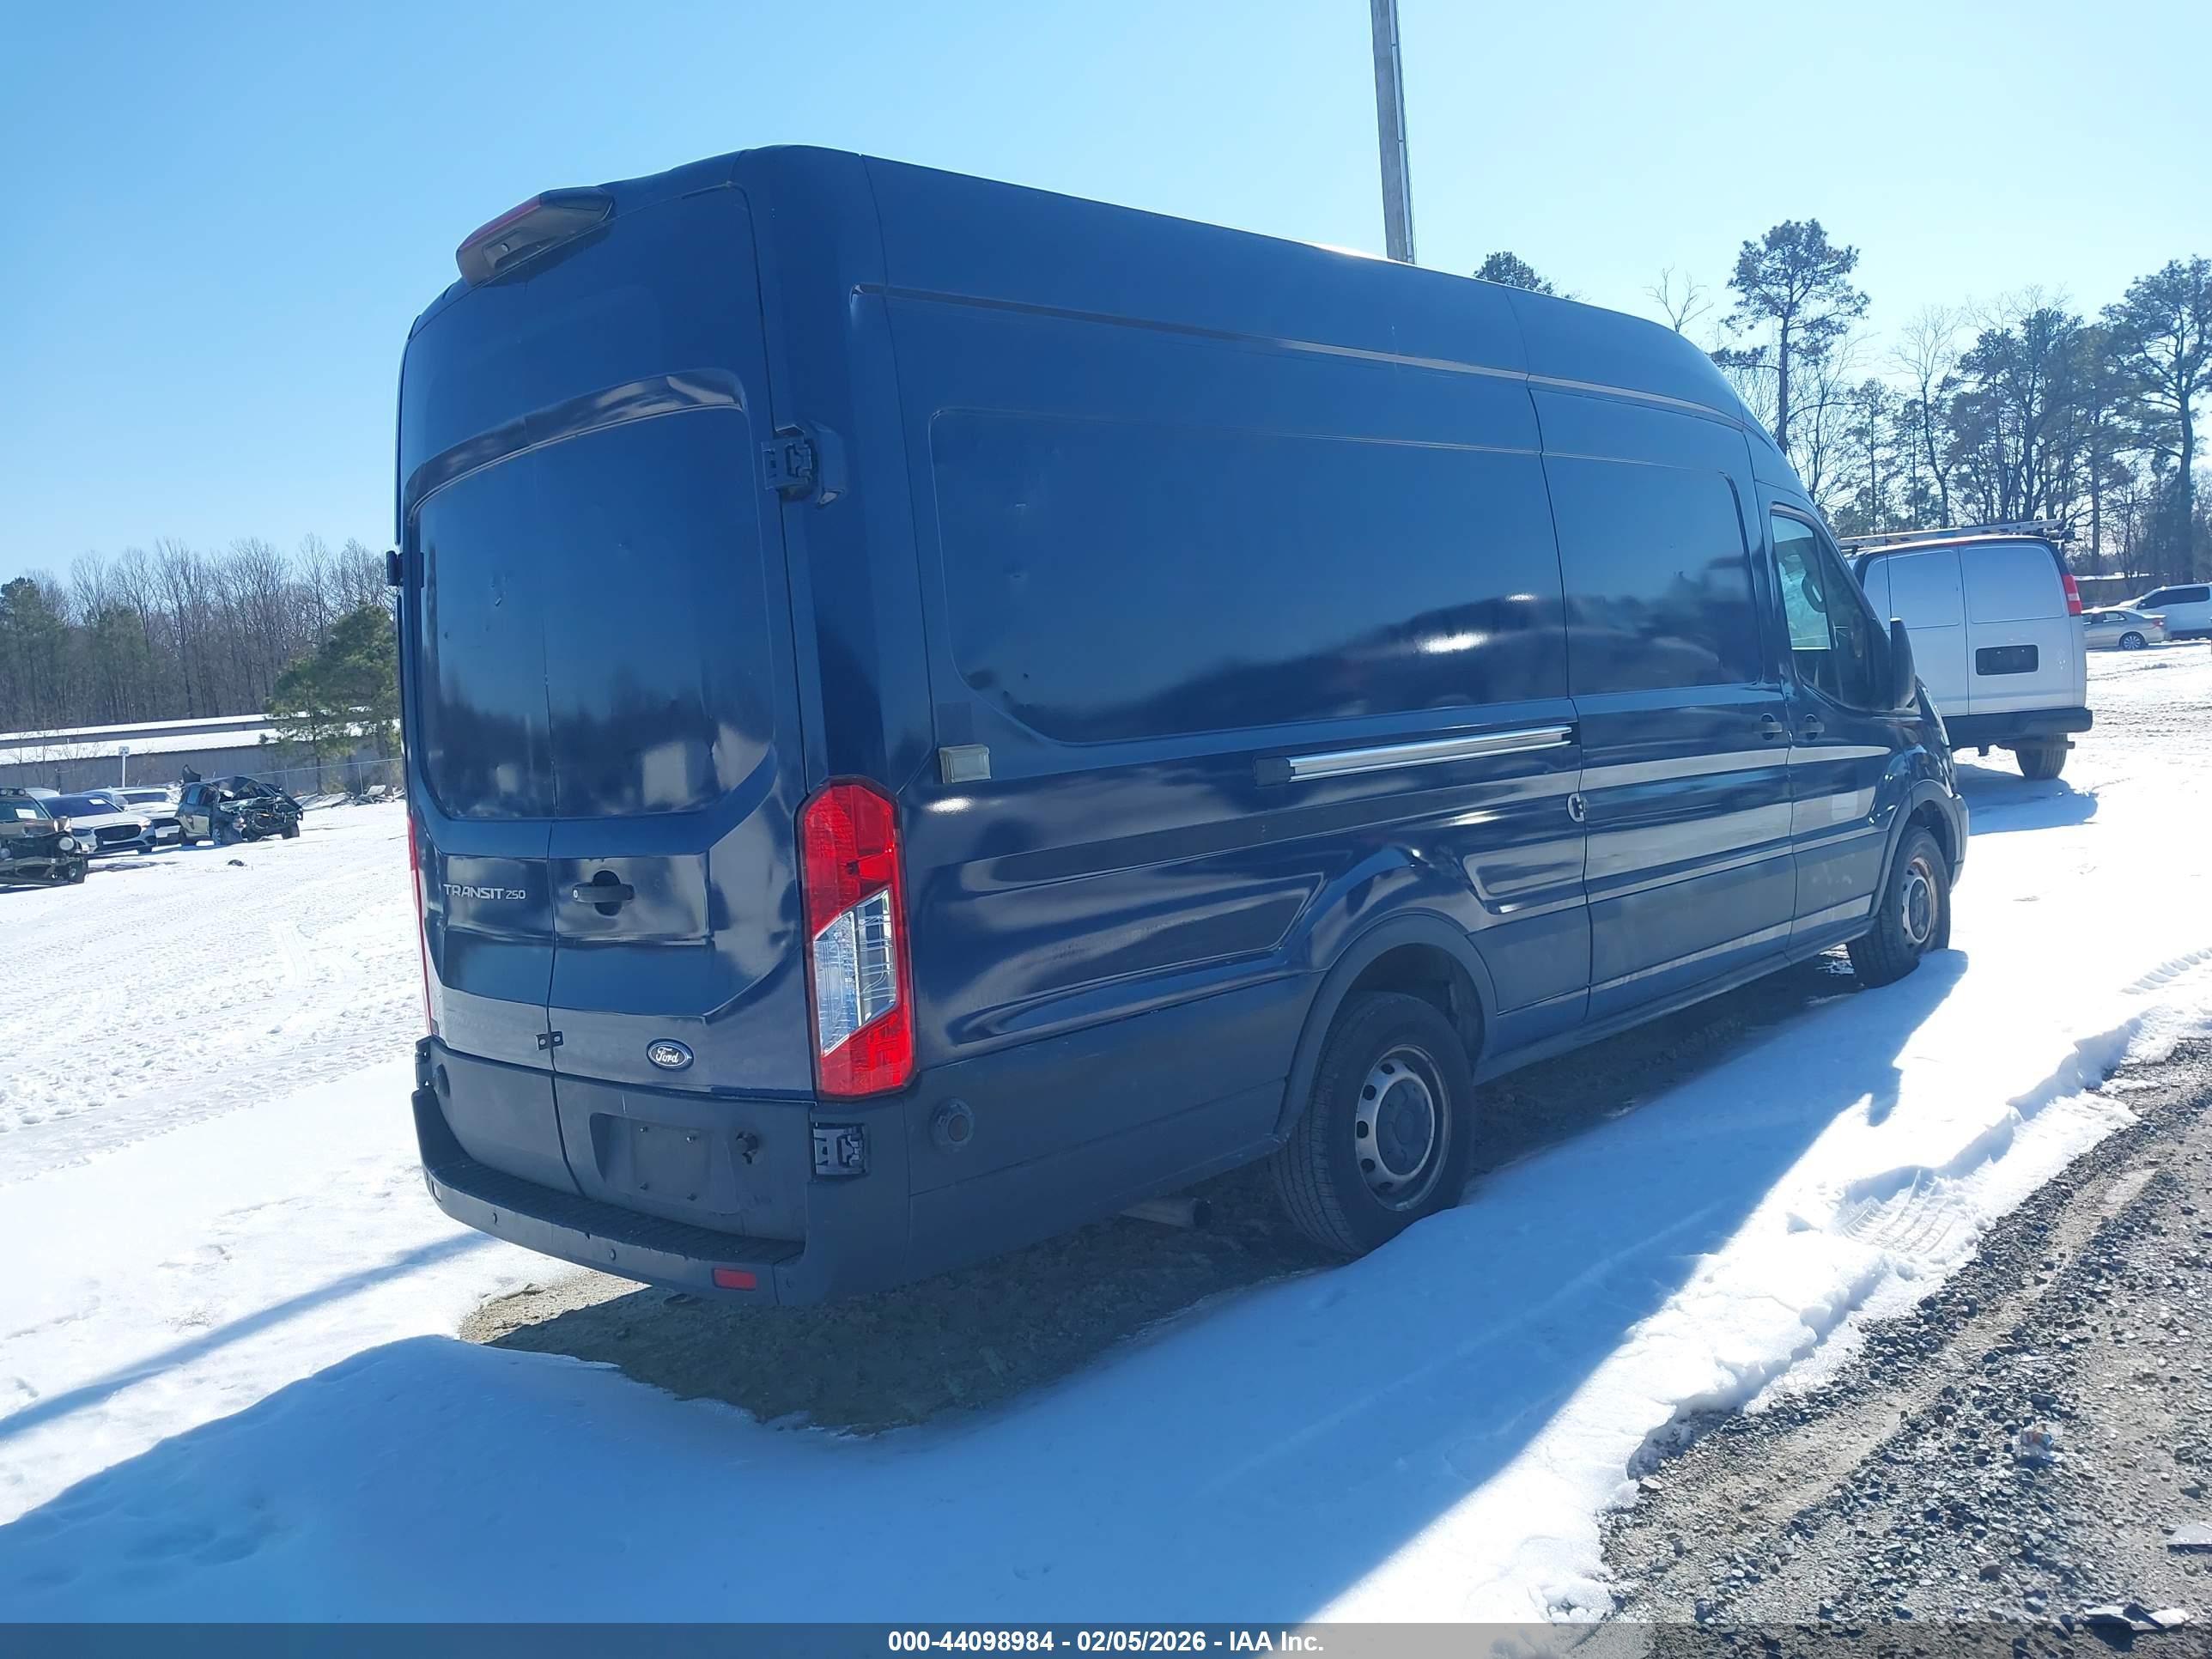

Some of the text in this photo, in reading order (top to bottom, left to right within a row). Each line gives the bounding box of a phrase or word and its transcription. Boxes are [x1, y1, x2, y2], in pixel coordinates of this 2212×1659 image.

[442, 884, 526, 900] TRANSIT 250
[655, 1046, 679, 1063] Ford
